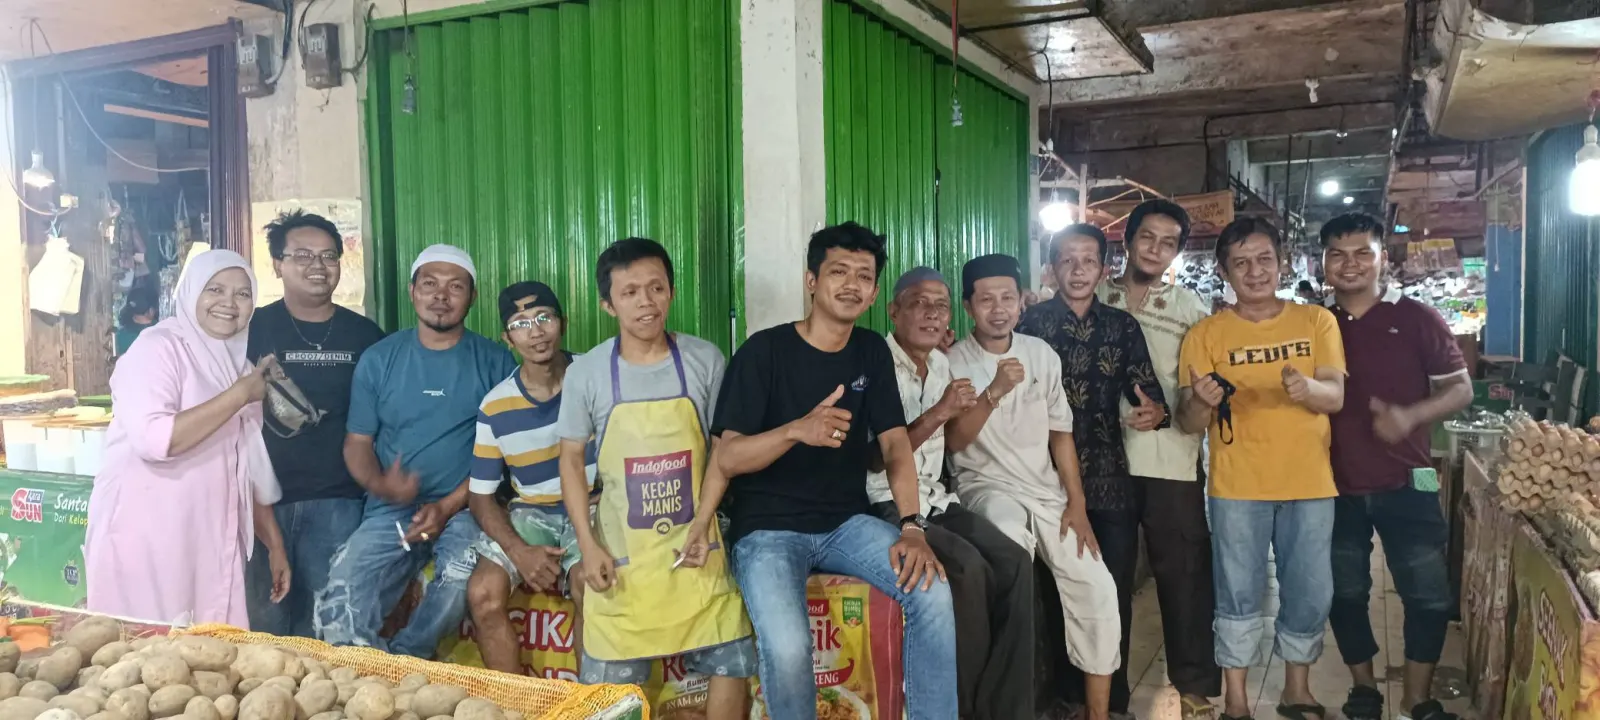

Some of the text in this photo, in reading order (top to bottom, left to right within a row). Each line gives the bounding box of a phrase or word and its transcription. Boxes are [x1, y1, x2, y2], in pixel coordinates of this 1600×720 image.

[632, 456, 687, 475] Indofood
[641, 479, 681, 500] KECAP
[54, 493, 88, 512] Santa
[642, 496, 682, 516] MANIS
